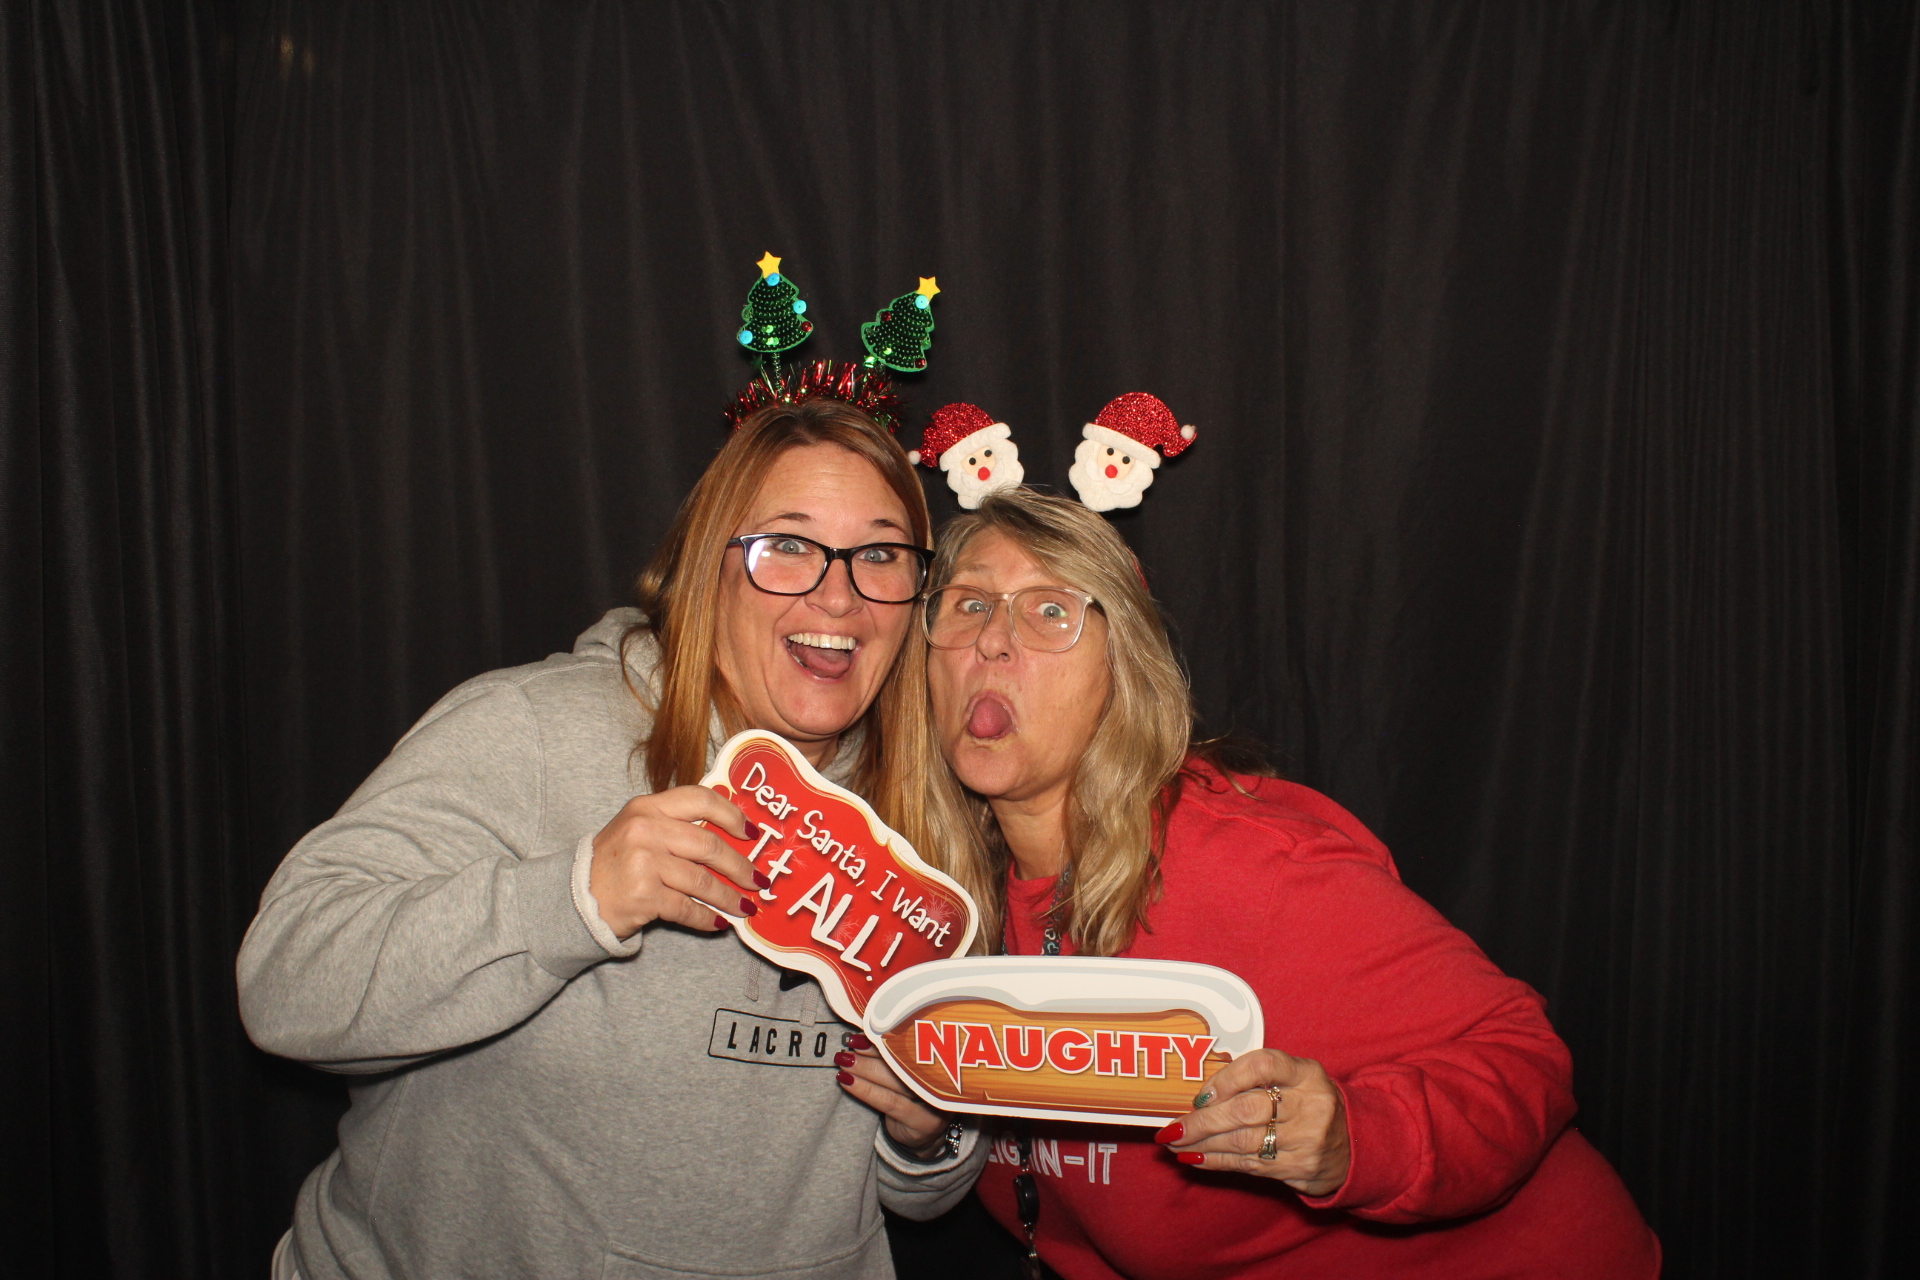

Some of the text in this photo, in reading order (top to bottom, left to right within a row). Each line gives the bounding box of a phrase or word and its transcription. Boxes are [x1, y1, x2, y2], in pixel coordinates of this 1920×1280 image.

[740, 762, 951, 948] Dear Santa, I Want
[748, 822, 903, 981] It ALL!
[914, 1019, 1219, 1094] NAUGHTY
